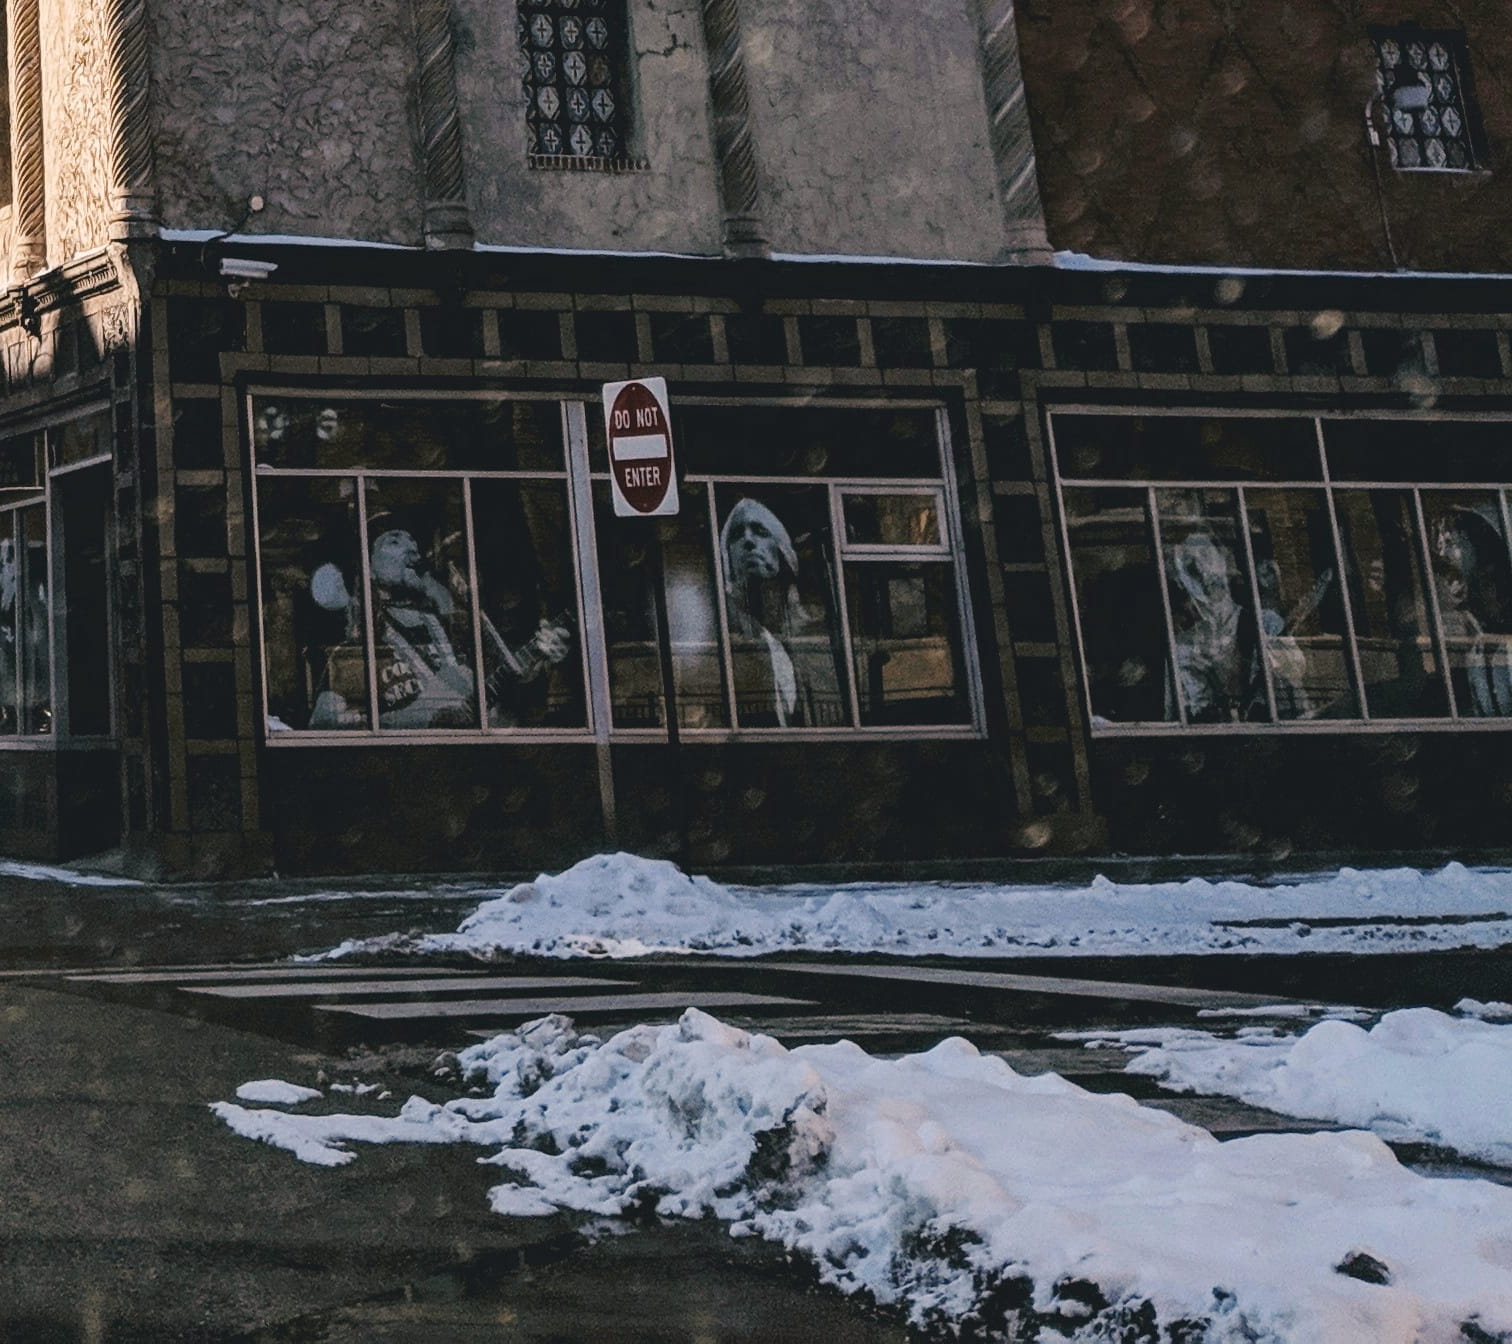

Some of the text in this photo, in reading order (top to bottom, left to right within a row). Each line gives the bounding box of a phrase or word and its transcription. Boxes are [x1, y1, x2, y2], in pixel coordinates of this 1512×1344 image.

[615, 406, 659, 430] DO NOT
[624, 466, 661, 488] ENTER
